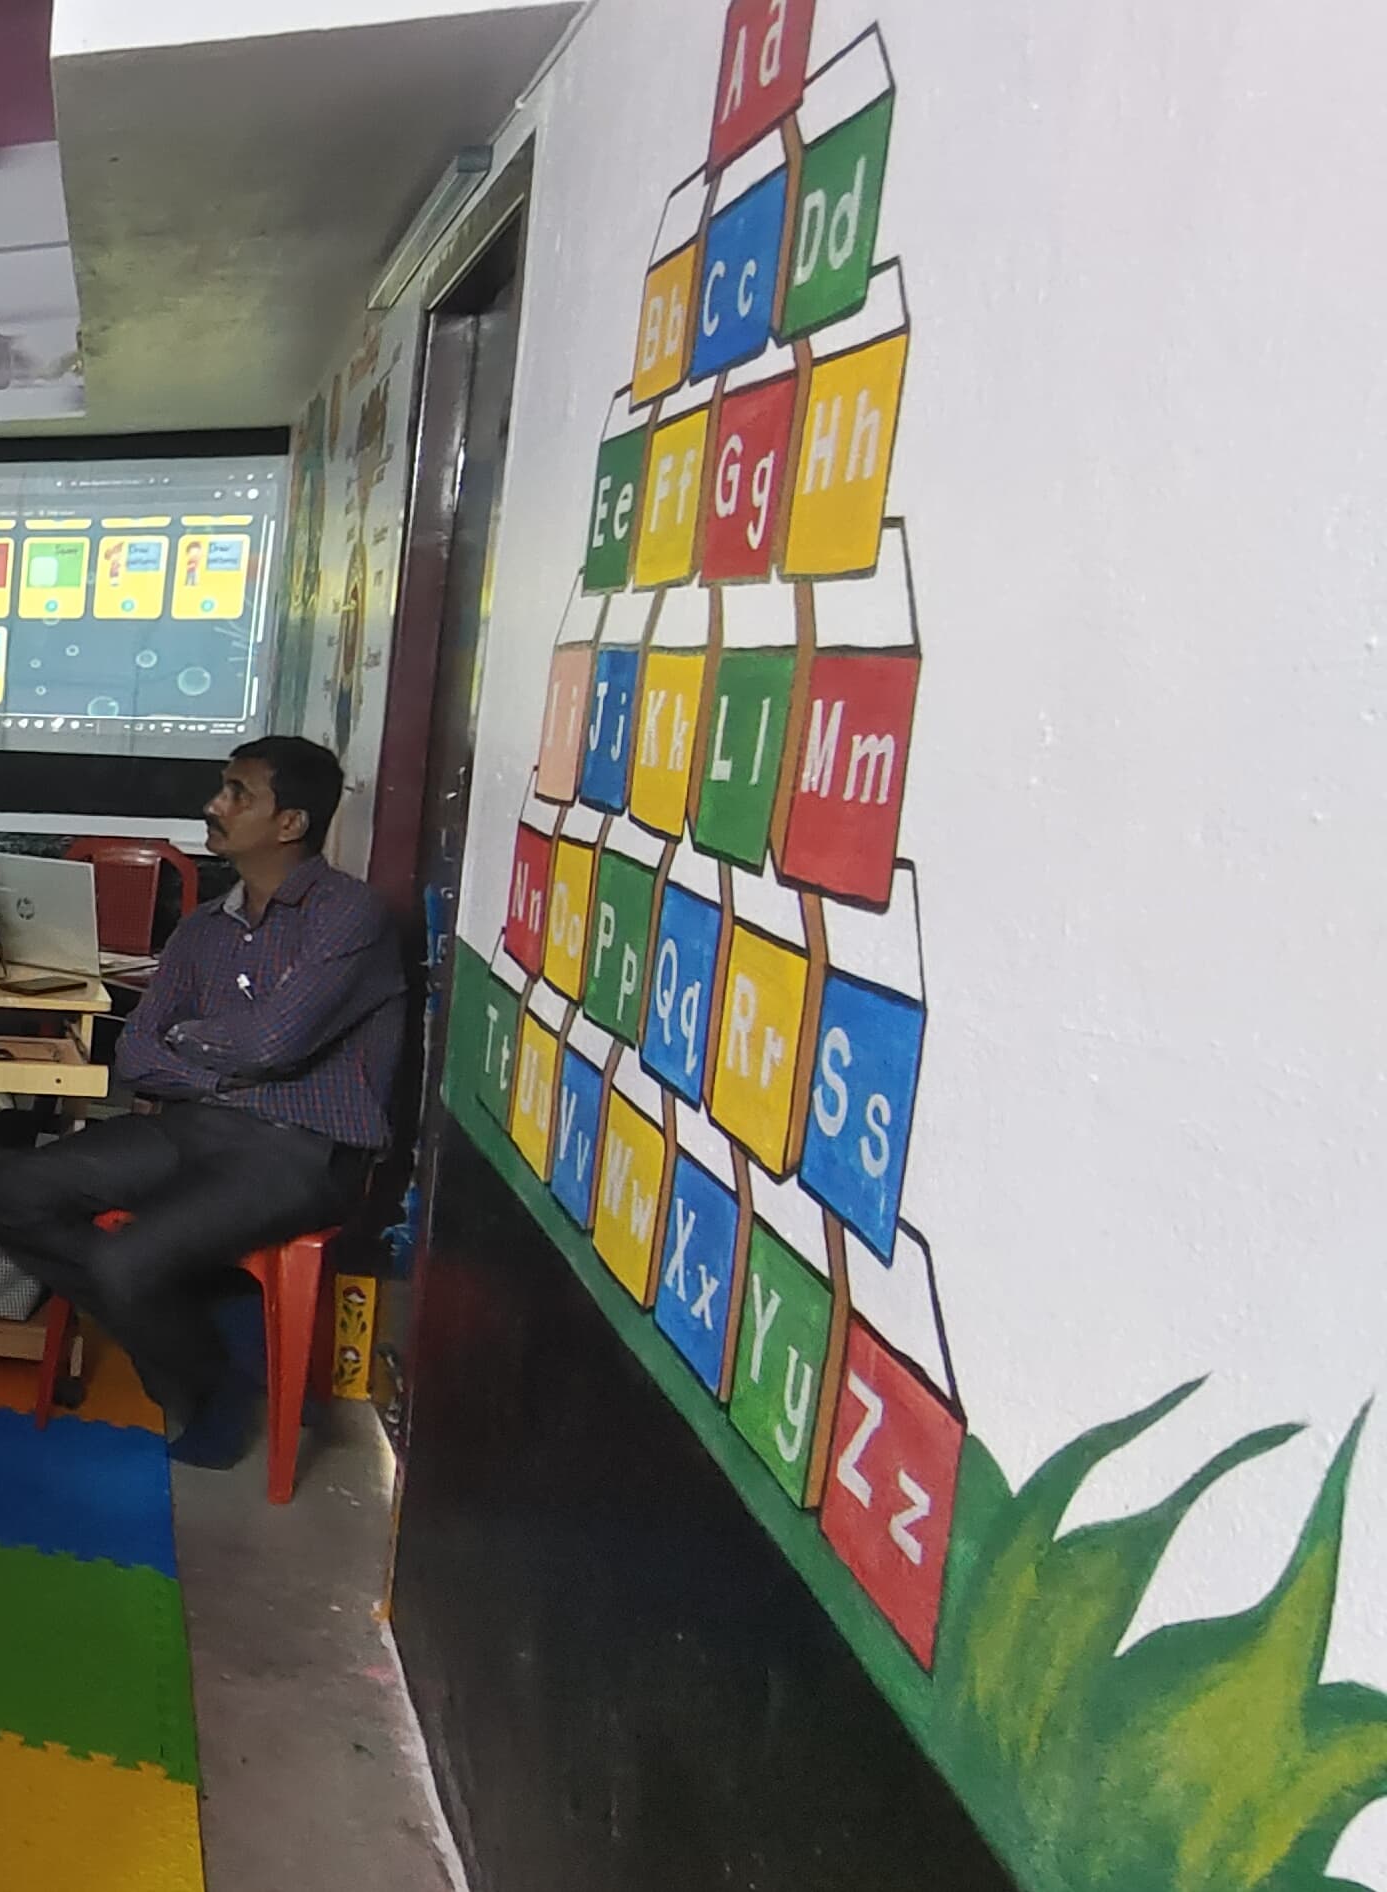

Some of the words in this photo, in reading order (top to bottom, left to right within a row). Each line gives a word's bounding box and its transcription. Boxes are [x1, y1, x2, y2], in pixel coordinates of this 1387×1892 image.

[793, 156, 866, 287] Dd
[641, 283, 684, 371] Bb
[701, 258, 757, 337] Cc
[648, 453, 697, 533] Ff
[715, 433, 775, 550] Gg
[803, 389, 879, 494] Hh
[592, 474, 633, 550] Ee
[589, 682, 627, 761] Jj
[640, 689, 688, 772] Kk
[800, 698, 896, 805] Mm
[514, 861, 542, 935] Nn
[552, 881, 582, 961] Oo
[593, 902, 637, 1022] Pp
[656, 937, 700, 1076] Qq
[485, 1003, 510, 1092] Tt
[727, 973, 785, 1089] Rr
[519, 1042, 550, 1131] Uu
[559, 1085, 591, 1182] Vv
[812, 1026, 892, 1179] Ss
[603, 1142, 653, 1246] Ww
[664, 1196, 720, 1331] Xx
[746, 1272, 814, 1464] Yy
[835, 1369, 931, 1566] Zz
